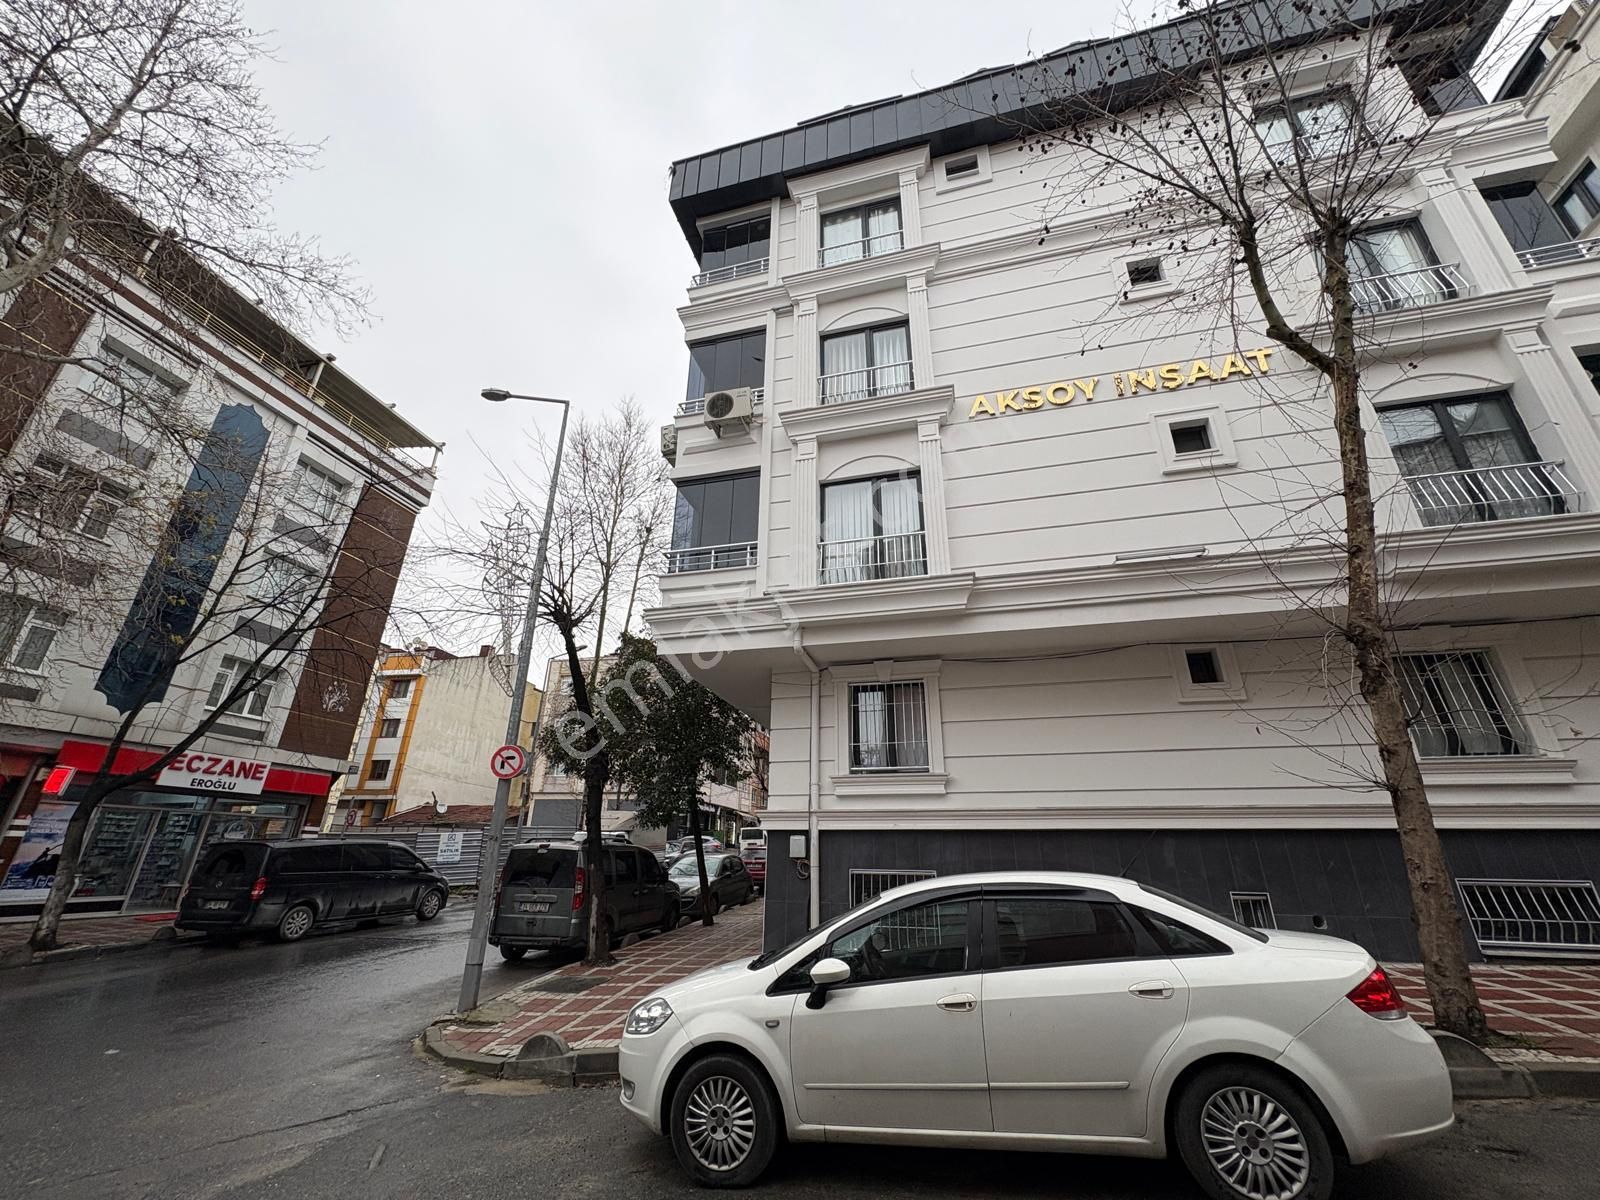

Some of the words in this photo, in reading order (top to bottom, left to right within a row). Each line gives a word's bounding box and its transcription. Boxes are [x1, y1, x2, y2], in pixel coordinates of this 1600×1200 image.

[969, 376, 1099, 418] AKSOY
[167, 753, 267, 781] ECZANE
[190, 778, 237, 791] EROĞLU
